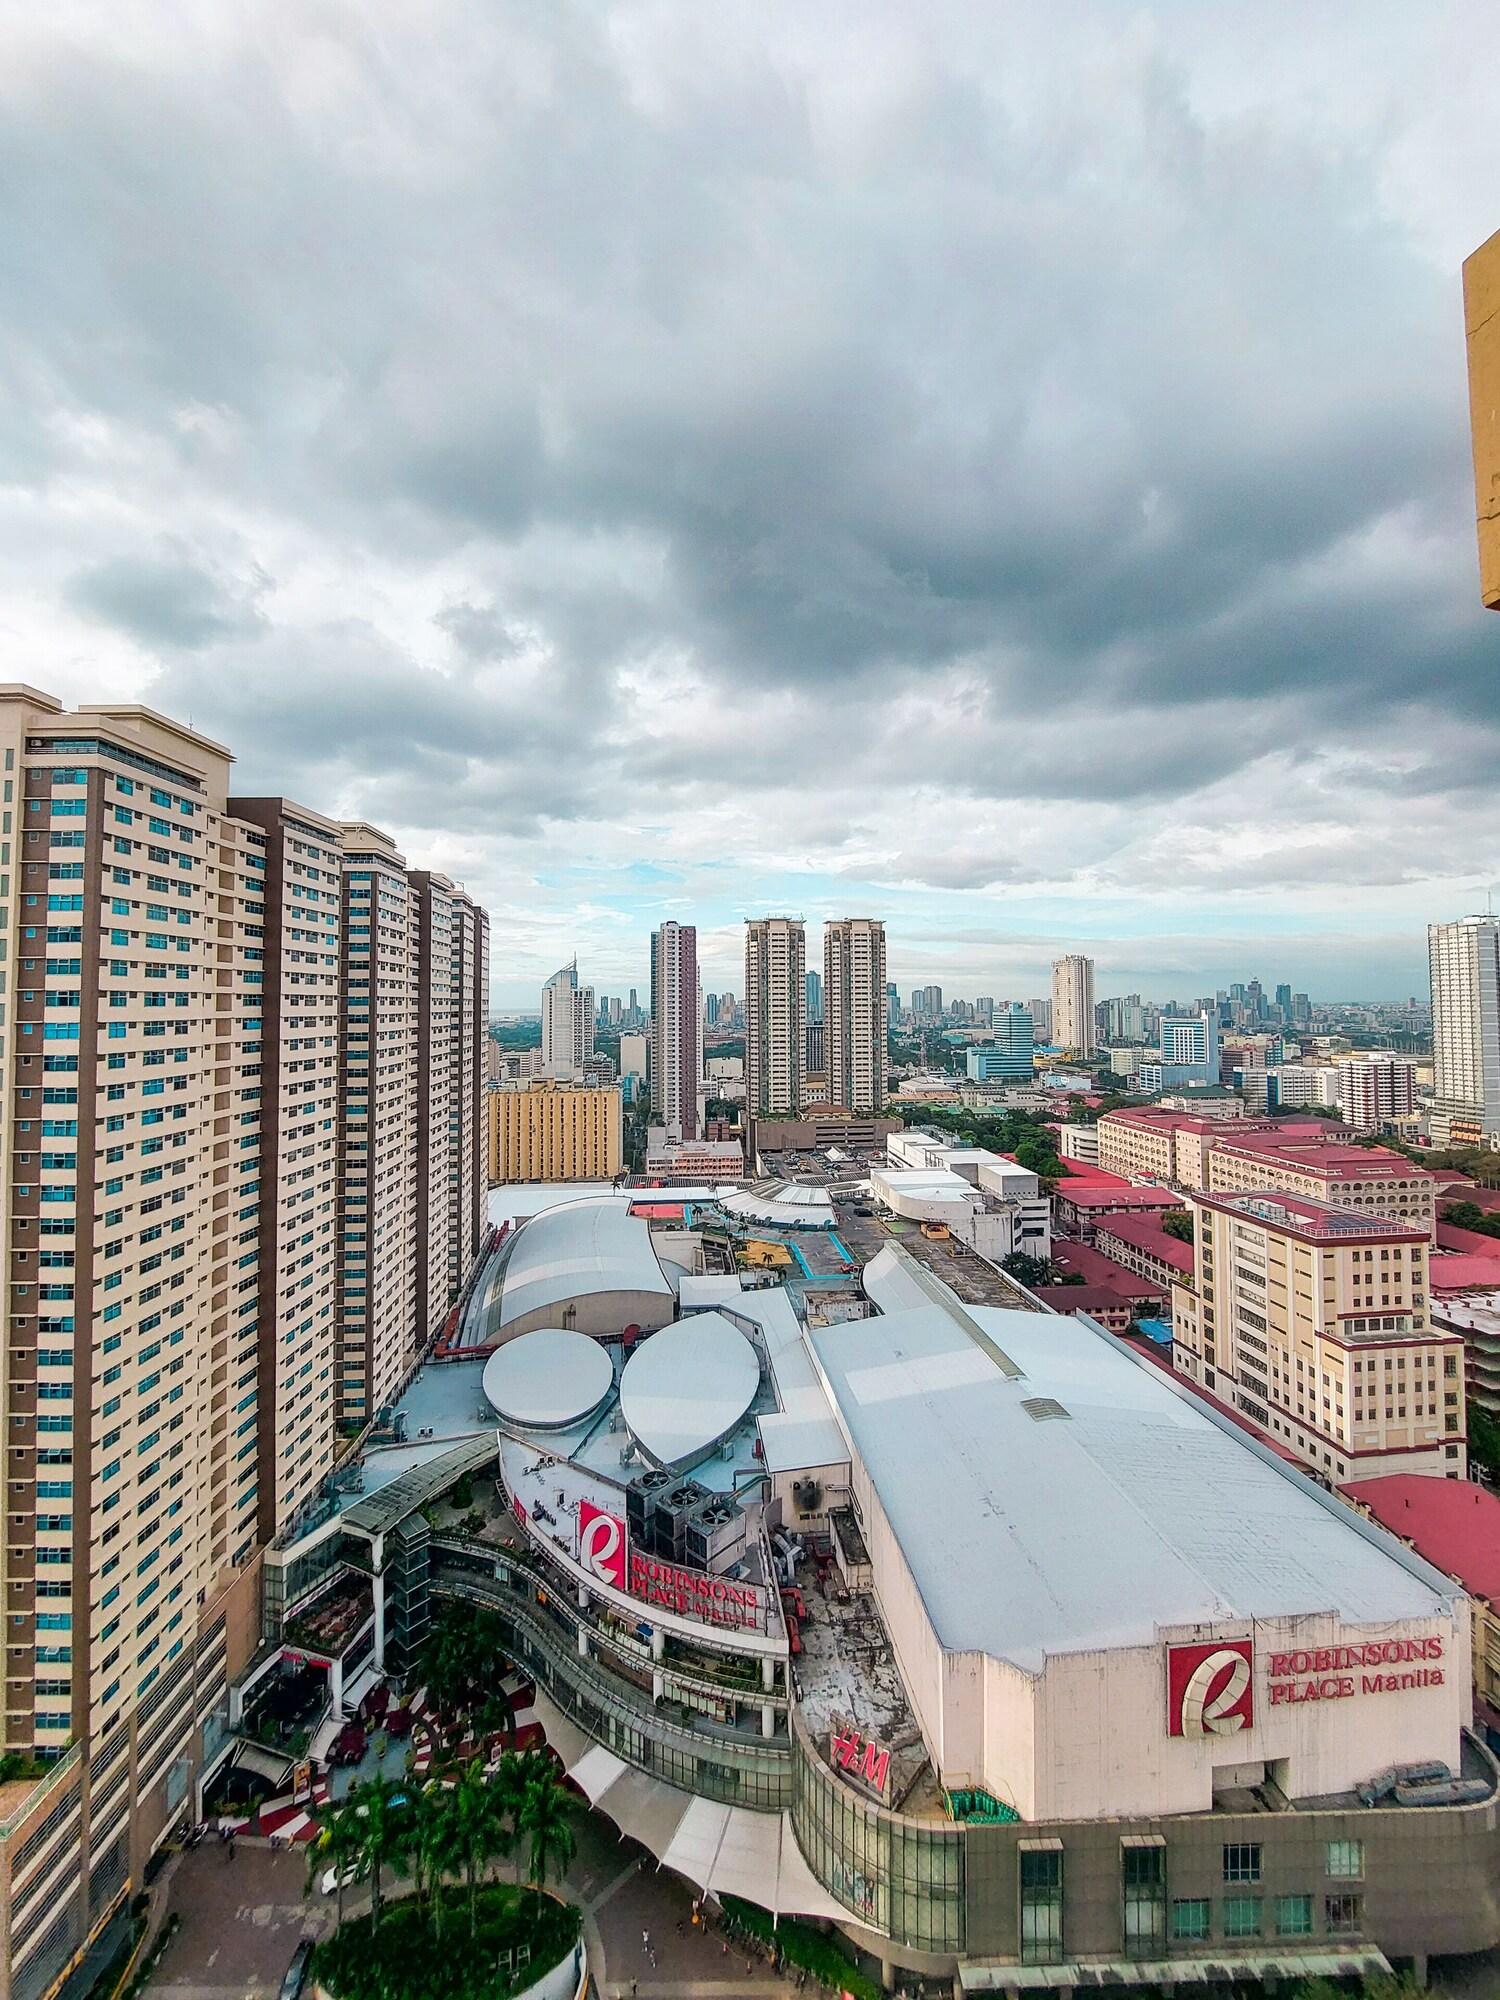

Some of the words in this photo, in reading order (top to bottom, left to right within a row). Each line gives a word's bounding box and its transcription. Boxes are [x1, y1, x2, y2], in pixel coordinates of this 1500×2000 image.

[631, 1553, 757, 1608] ROBINSONS
[631, 1575, 689, 1615] PLACE
[1269, 1636, 1443, 1677] ROBINSONS
[1270, 1677, 1355, 1705] PLACE
[1362, 1668, 1445, 1695] Manila
[832, 1724, 890, 1793] H&M
